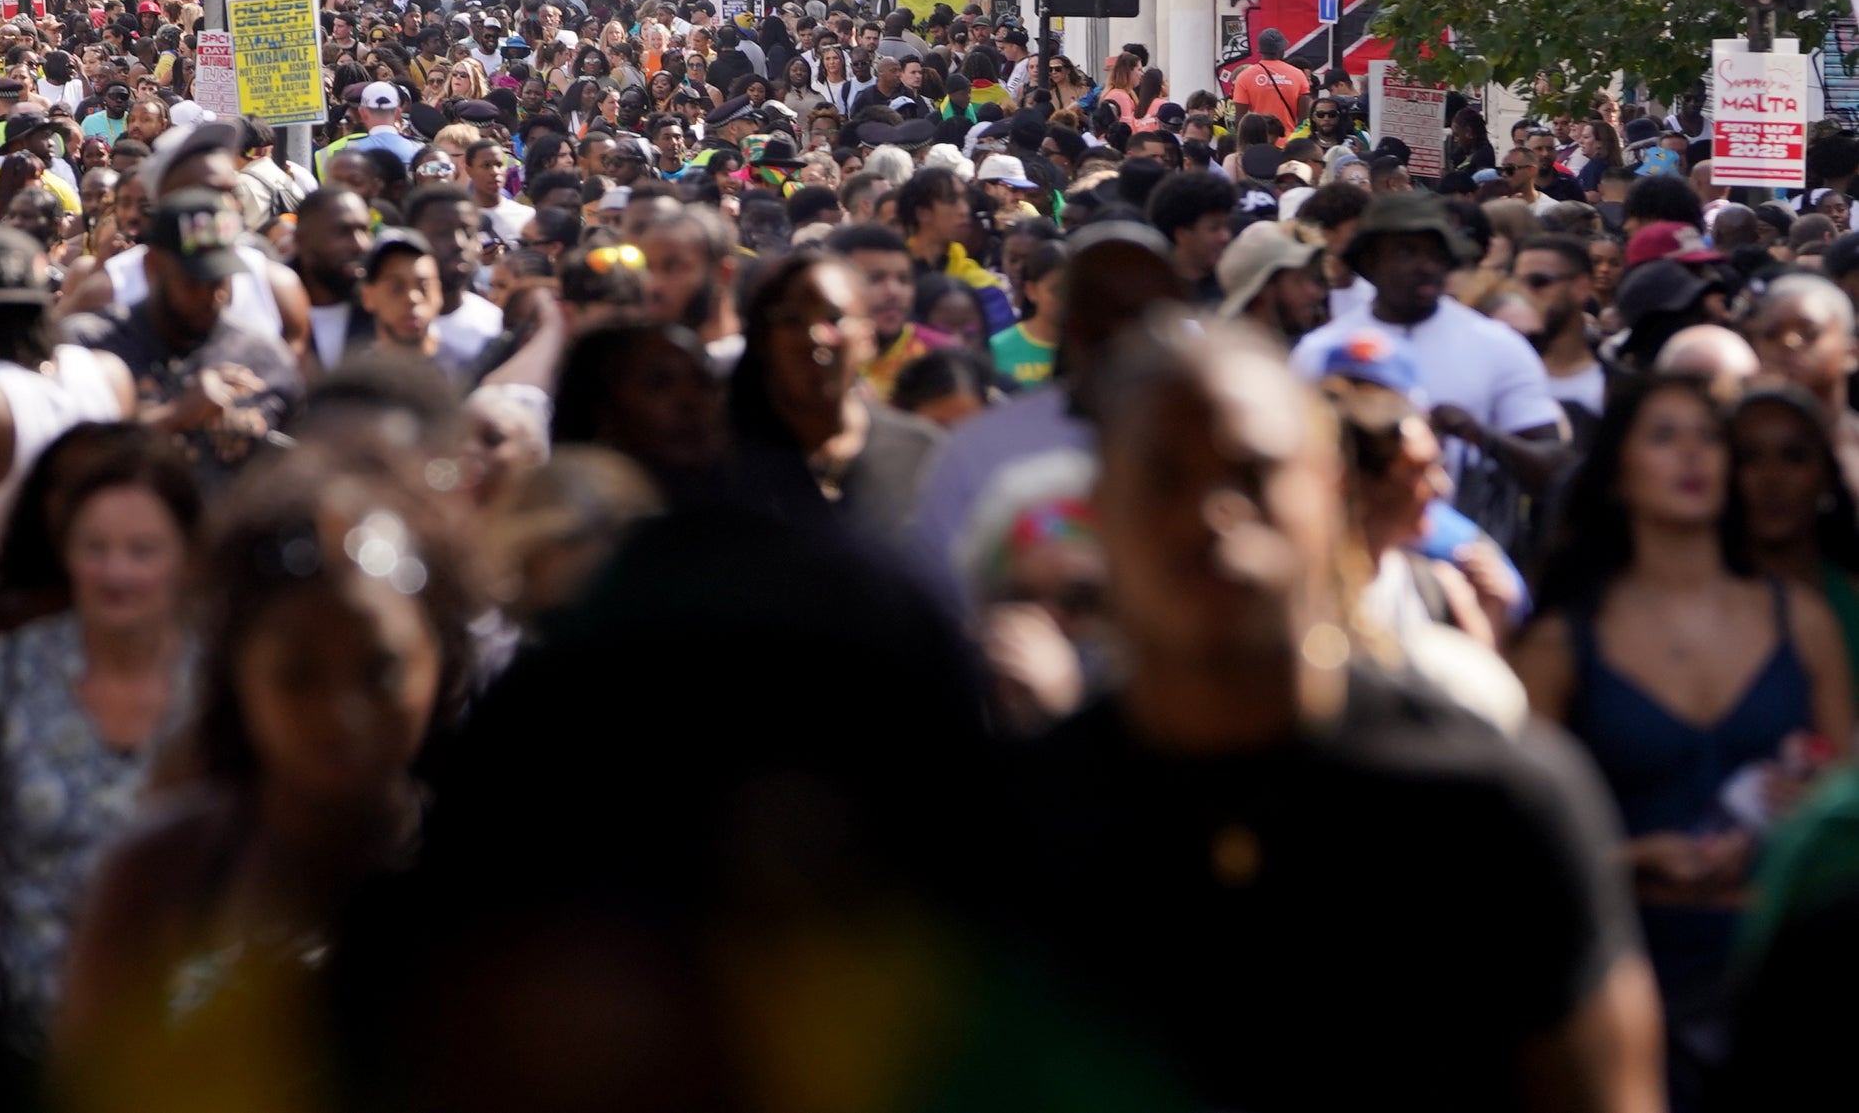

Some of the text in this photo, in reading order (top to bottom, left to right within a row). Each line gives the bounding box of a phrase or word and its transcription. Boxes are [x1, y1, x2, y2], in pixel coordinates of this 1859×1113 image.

[244, 47, 309, 66] TIMBAWOLF
[1722, 93, 1797, 113] MALTA
[1763, 124, 1797, 134] MAY
[1762, 134, 1802, 144] JUNE
[1729, 143, 1789, 158] 2025
